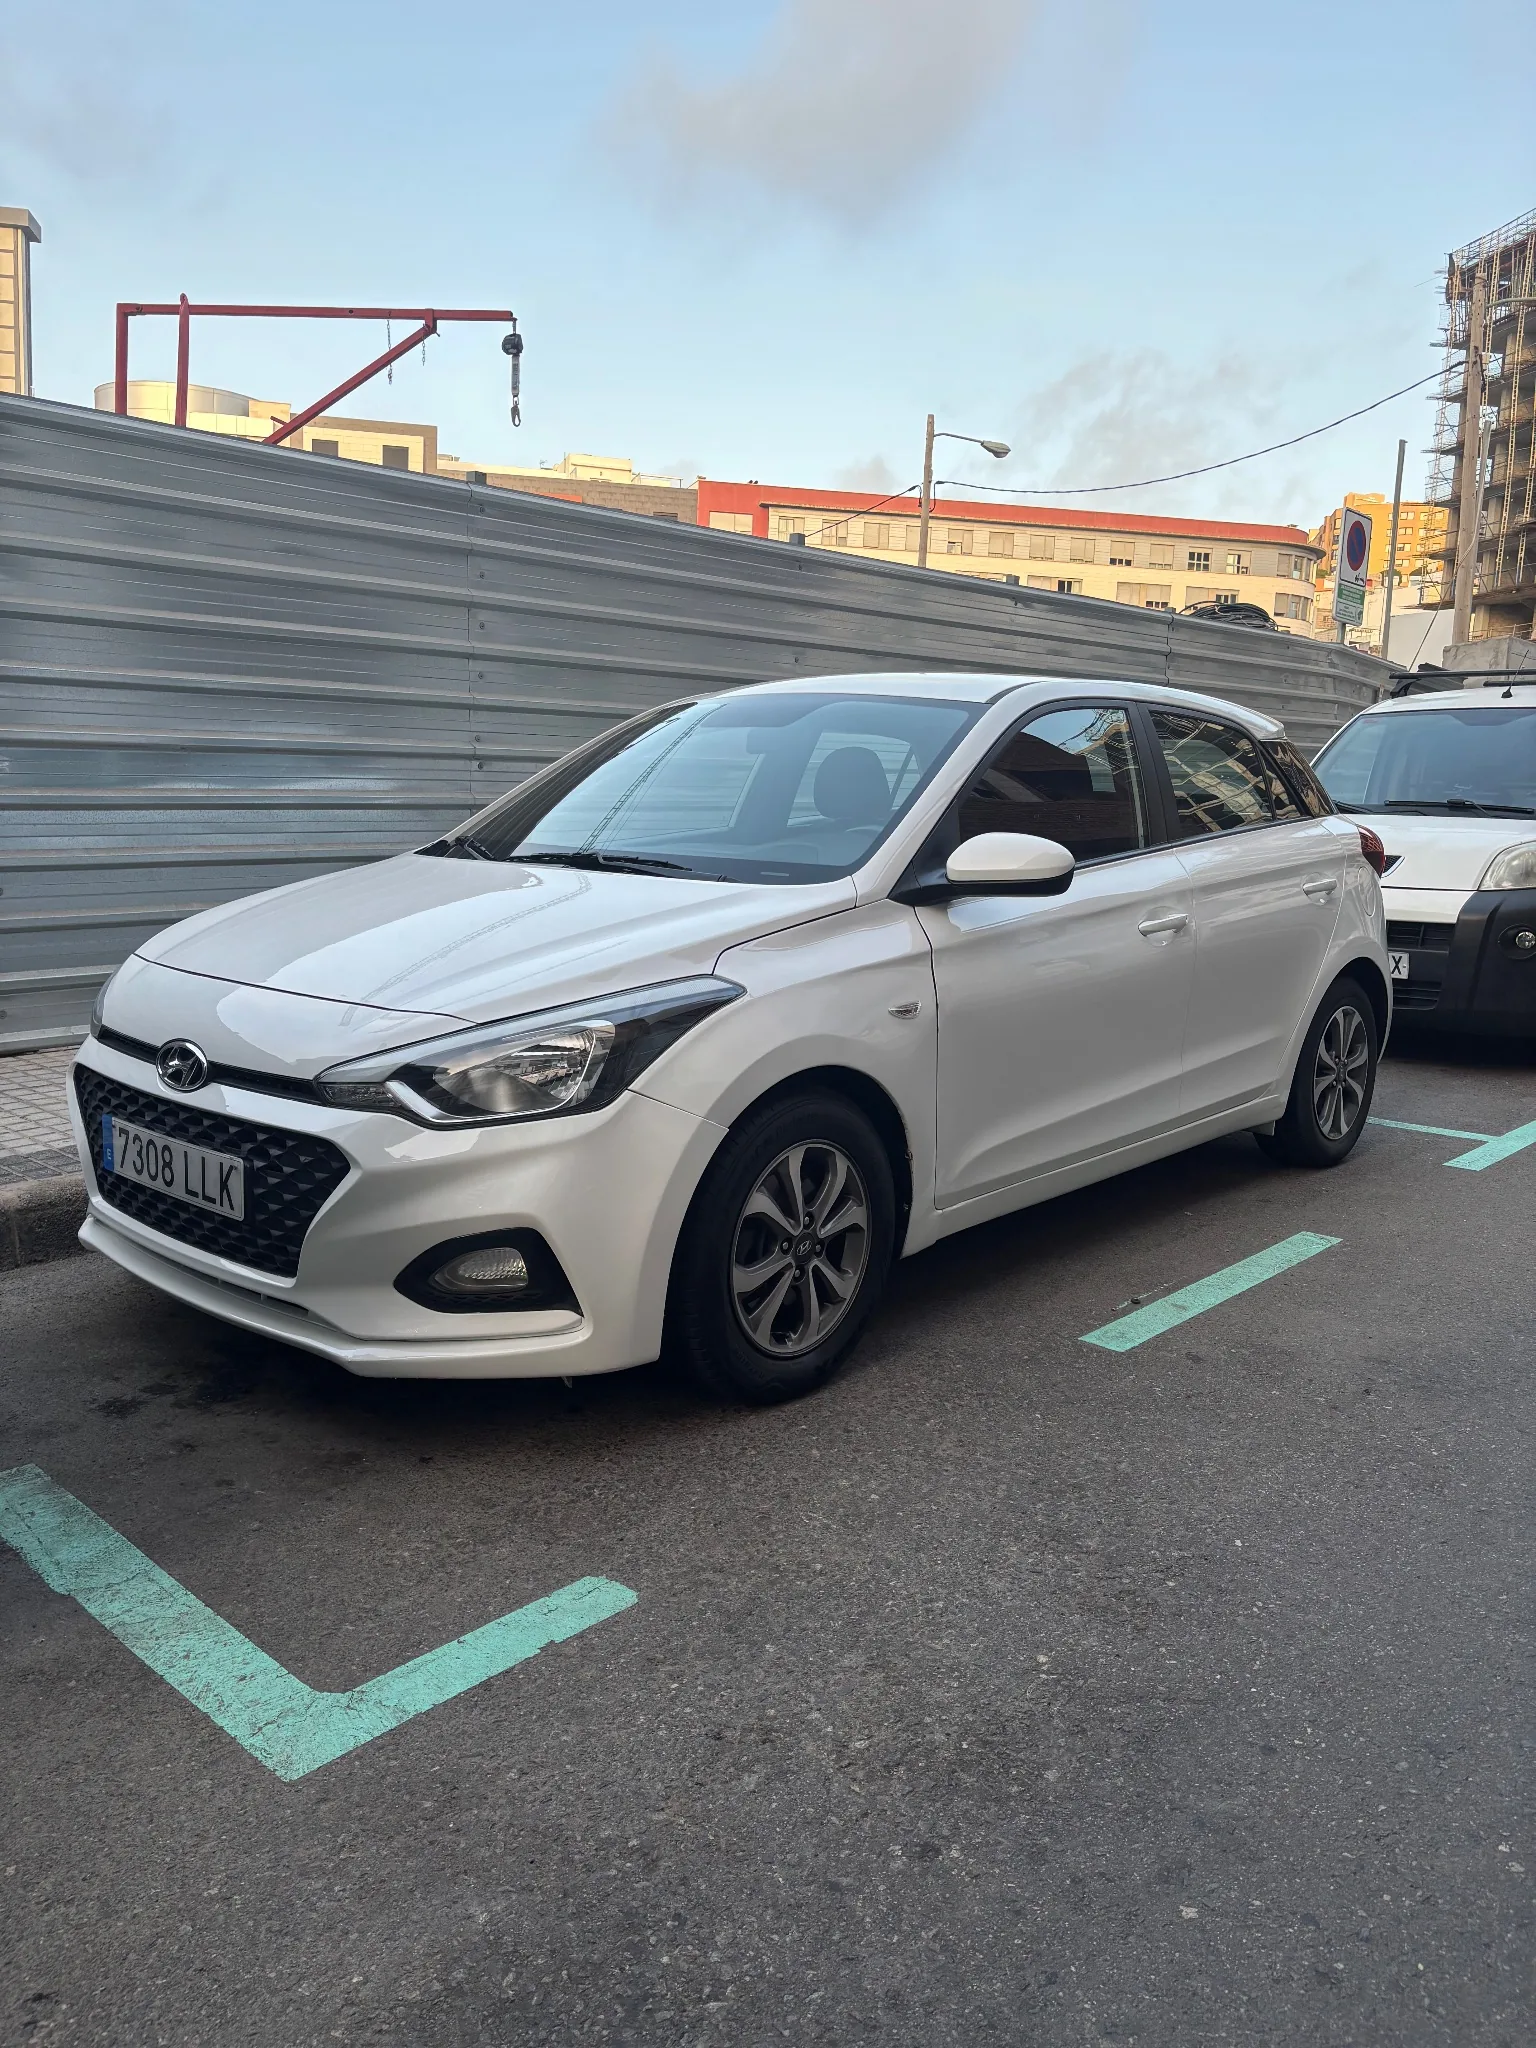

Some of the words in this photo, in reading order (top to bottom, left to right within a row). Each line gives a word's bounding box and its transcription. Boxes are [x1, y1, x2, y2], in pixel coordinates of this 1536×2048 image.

[1391, 955, 1403, 975] X
[118, 1127, 175, 1187] 7308
[184, 1150, 235, 1211] LLK
